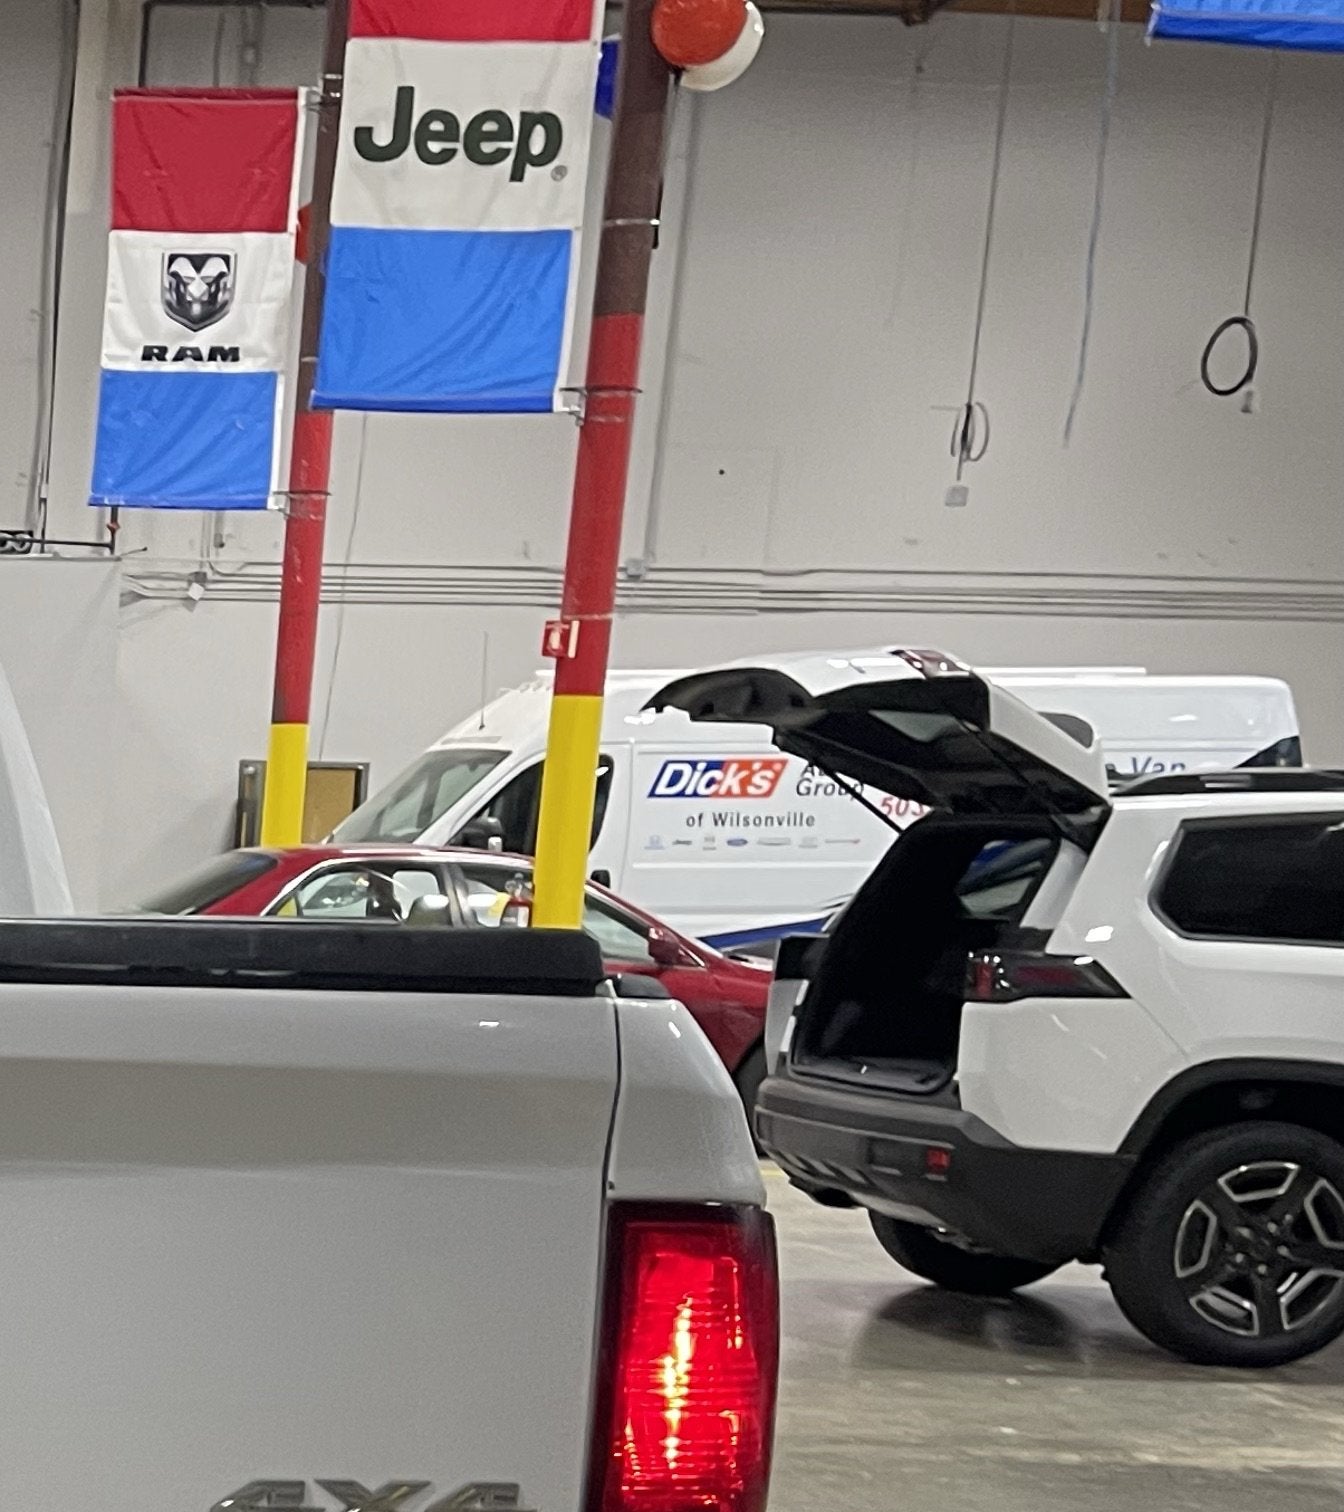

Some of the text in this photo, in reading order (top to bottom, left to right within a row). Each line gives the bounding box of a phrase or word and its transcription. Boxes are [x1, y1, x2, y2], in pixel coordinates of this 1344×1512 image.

[354, 86, 563, 182] Jeep
[141, 345, 240, 363] RAM
[654, 761, 777, 796] Dick's
[686, 812, 816, 827] of Wilsonville
